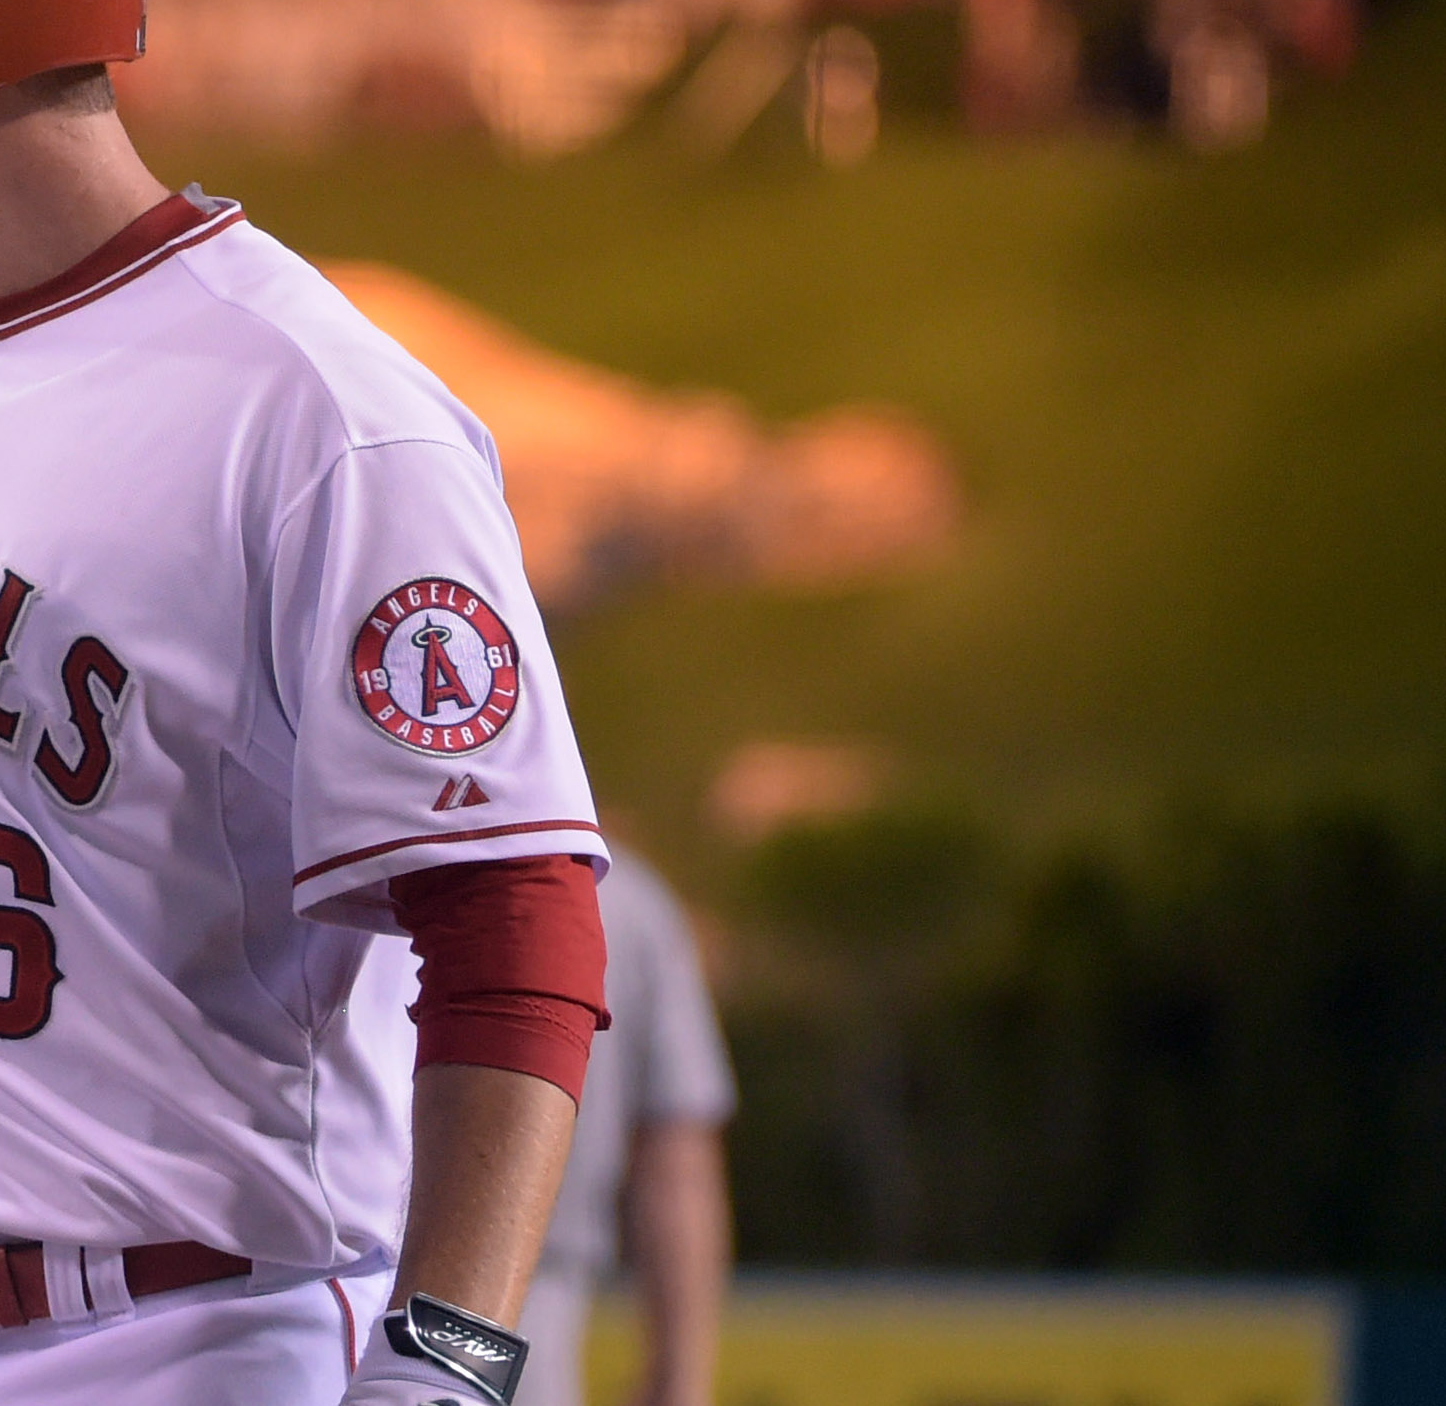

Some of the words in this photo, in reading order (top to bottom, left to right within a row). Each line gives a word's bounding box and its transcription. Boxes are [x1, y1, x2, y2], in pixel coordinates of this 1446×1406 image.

[370, 583, 479, 635] ANGELS
[358, 667, 392, 694] 19
[411, 613, 477, 717] A
[484, 643, 514, 669] 61
[377, 687, 516, 749] BASEBALL
